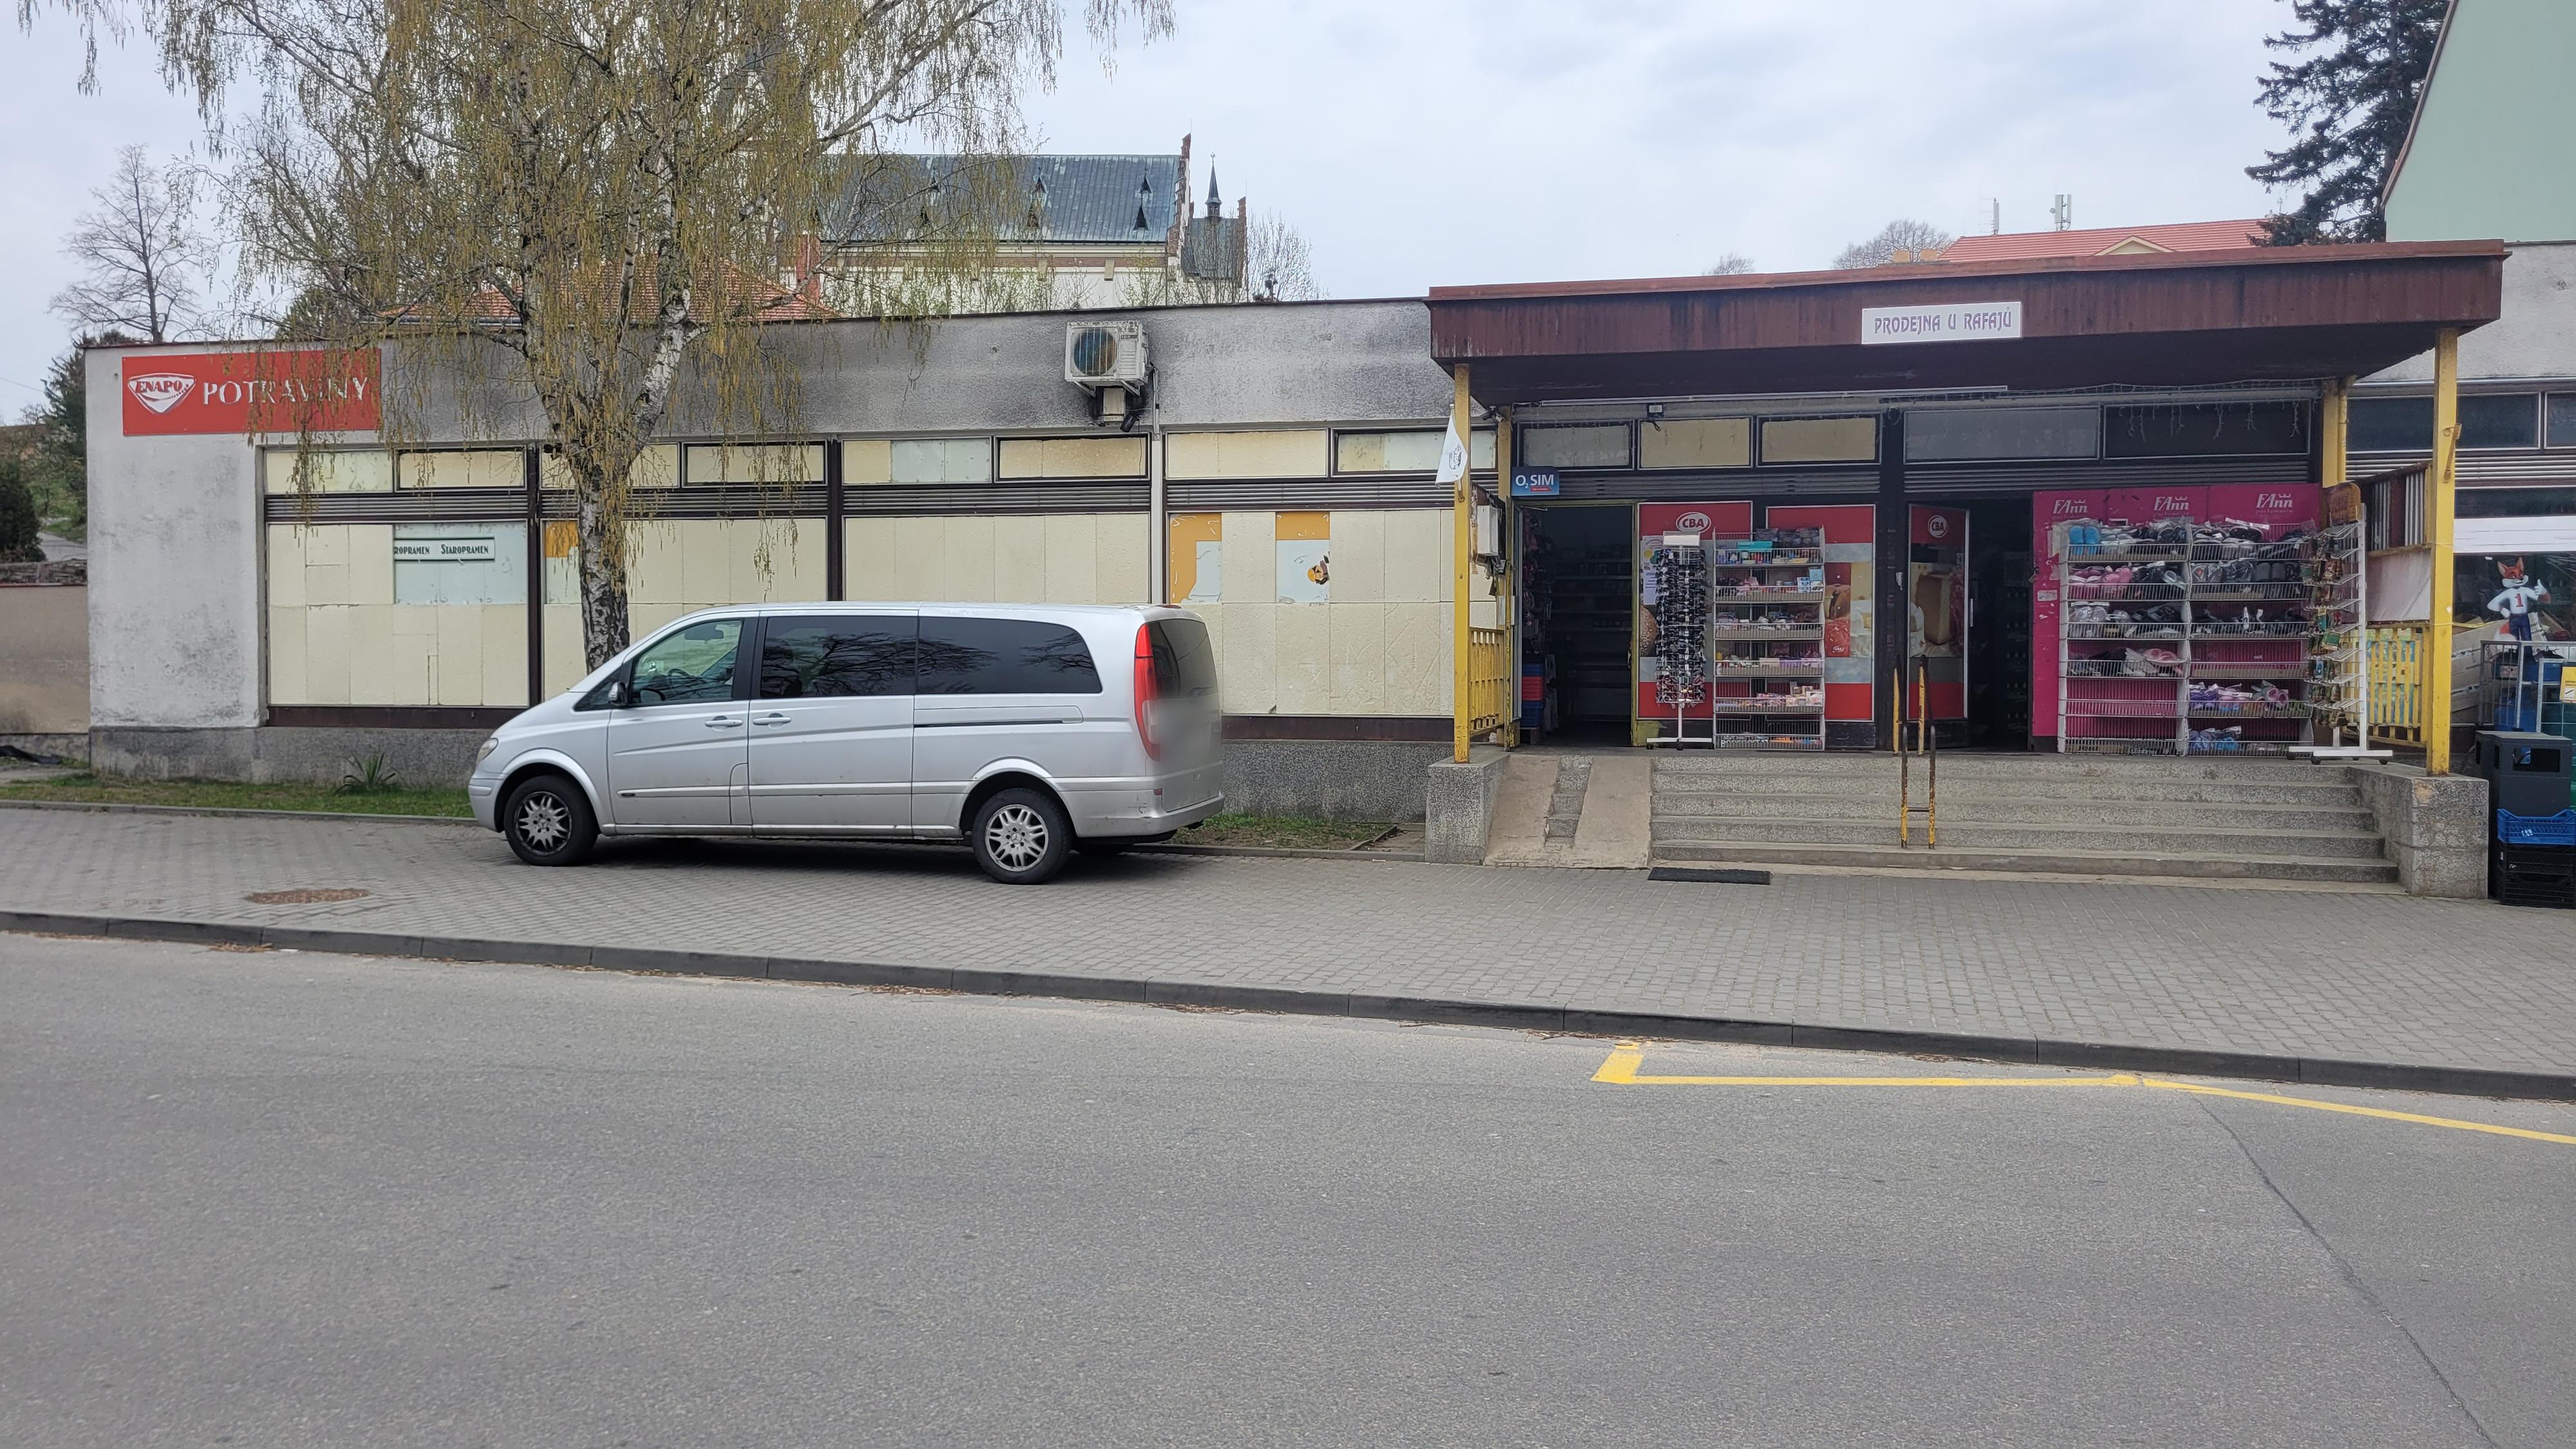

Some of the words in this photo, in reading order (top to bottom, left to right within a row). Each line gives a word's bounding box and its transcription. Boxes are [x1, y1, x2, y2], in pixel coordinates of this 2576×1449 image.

[1875, 314, 1940, 335] PRODEJNA
[1948, 314, 1956, 330] U
[1964, 306, 2011, 332] RAFAJŮ
[135, 380, 183, 393] ENAPO
[1530, 474, 1554, 486] SIM
[1681, 518, 1705, 528] CBA
[1932, 522, 1944, 531] CBA
[441, 544, 489, 554] STAROPRAMEN
[2515, 593, 2524, 607] 1
